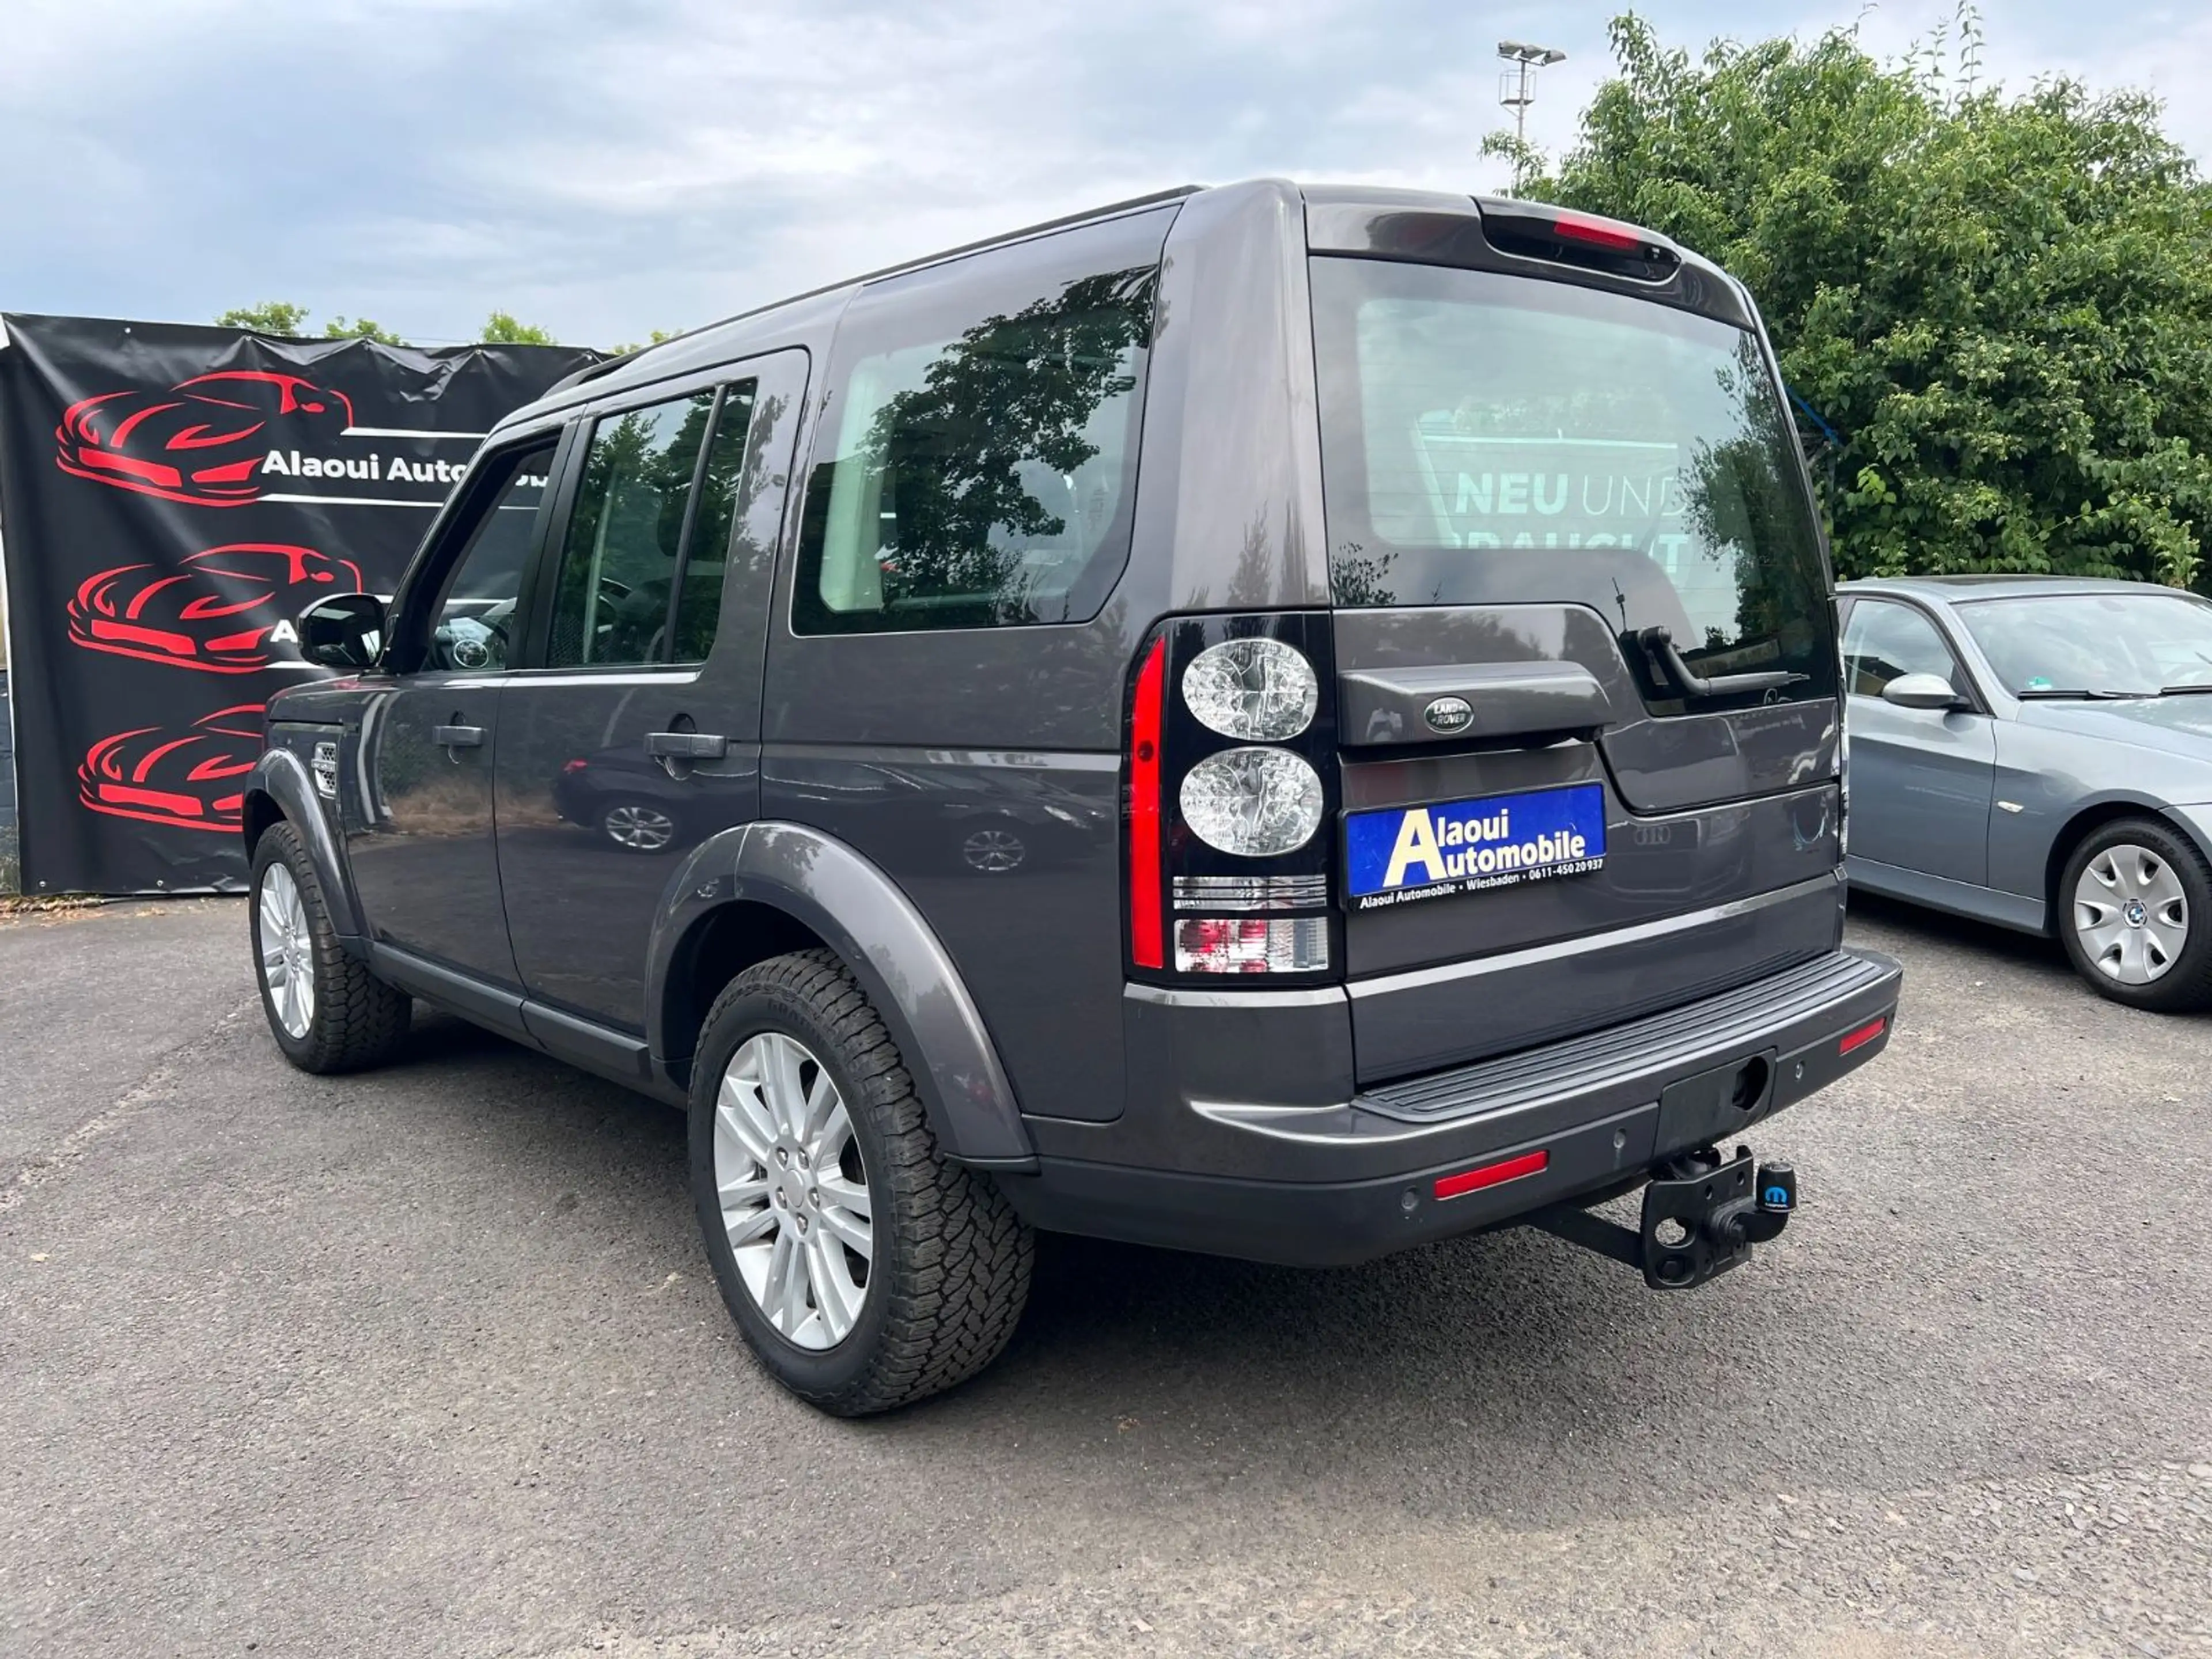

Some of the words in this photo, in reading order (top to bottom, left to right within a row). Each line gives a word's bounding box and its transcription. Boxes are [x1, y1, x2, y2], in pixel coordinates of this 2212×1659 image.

[262, 450, 380, 479] Alaoui
[1456, 472, 1569, 514] NEU
[1434, 703, 1458, 714] LAND
[1437, 713, 1466, 725] ROVER
[1360, 893, 1394, 909] Alaoui
[1396, 884, 1456, 902] Automobile
[1467, 874, 1520, 890] Wiesbaden
